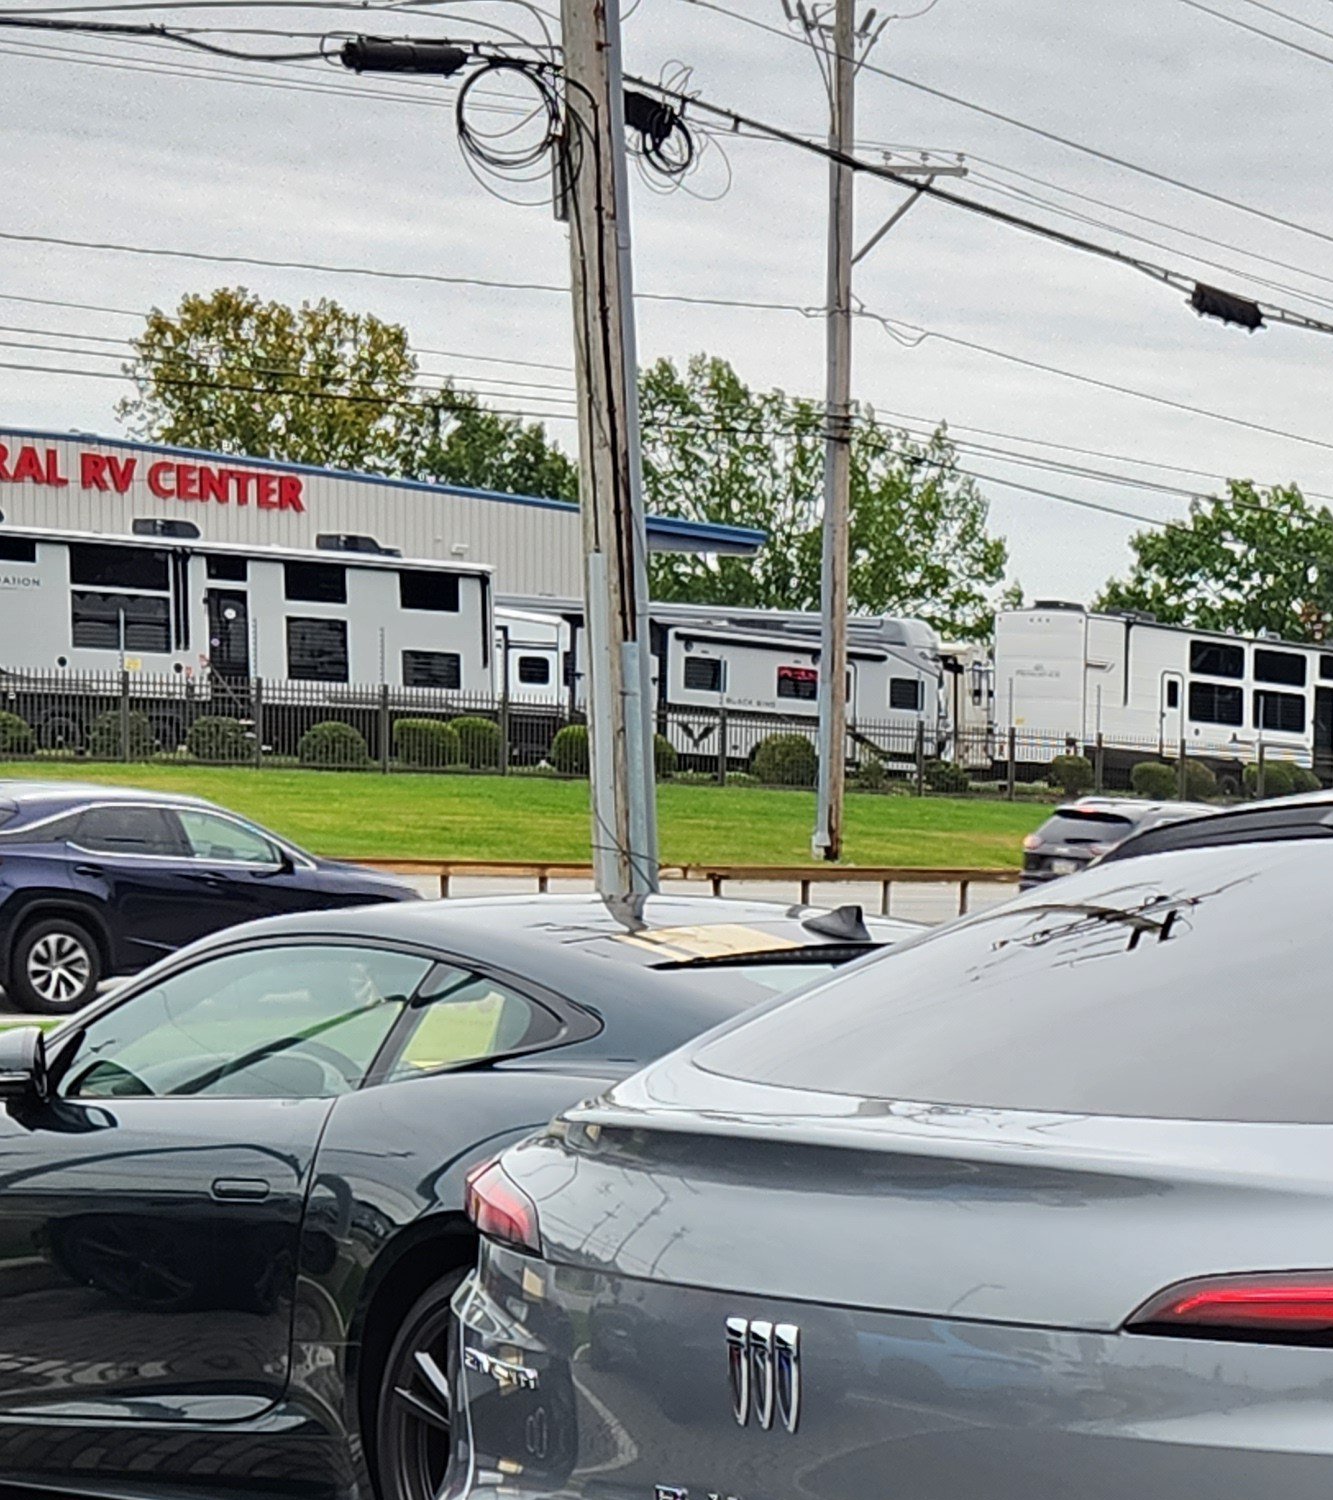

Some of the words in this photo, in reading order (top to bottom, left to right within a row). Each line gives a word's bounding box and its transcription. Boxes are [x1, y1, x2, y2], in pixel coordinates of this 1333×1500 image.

[81, 453, 137, 495] RV
[147, 461, 305, 513] CENTER
[0, 576, 40, 587] ATION
